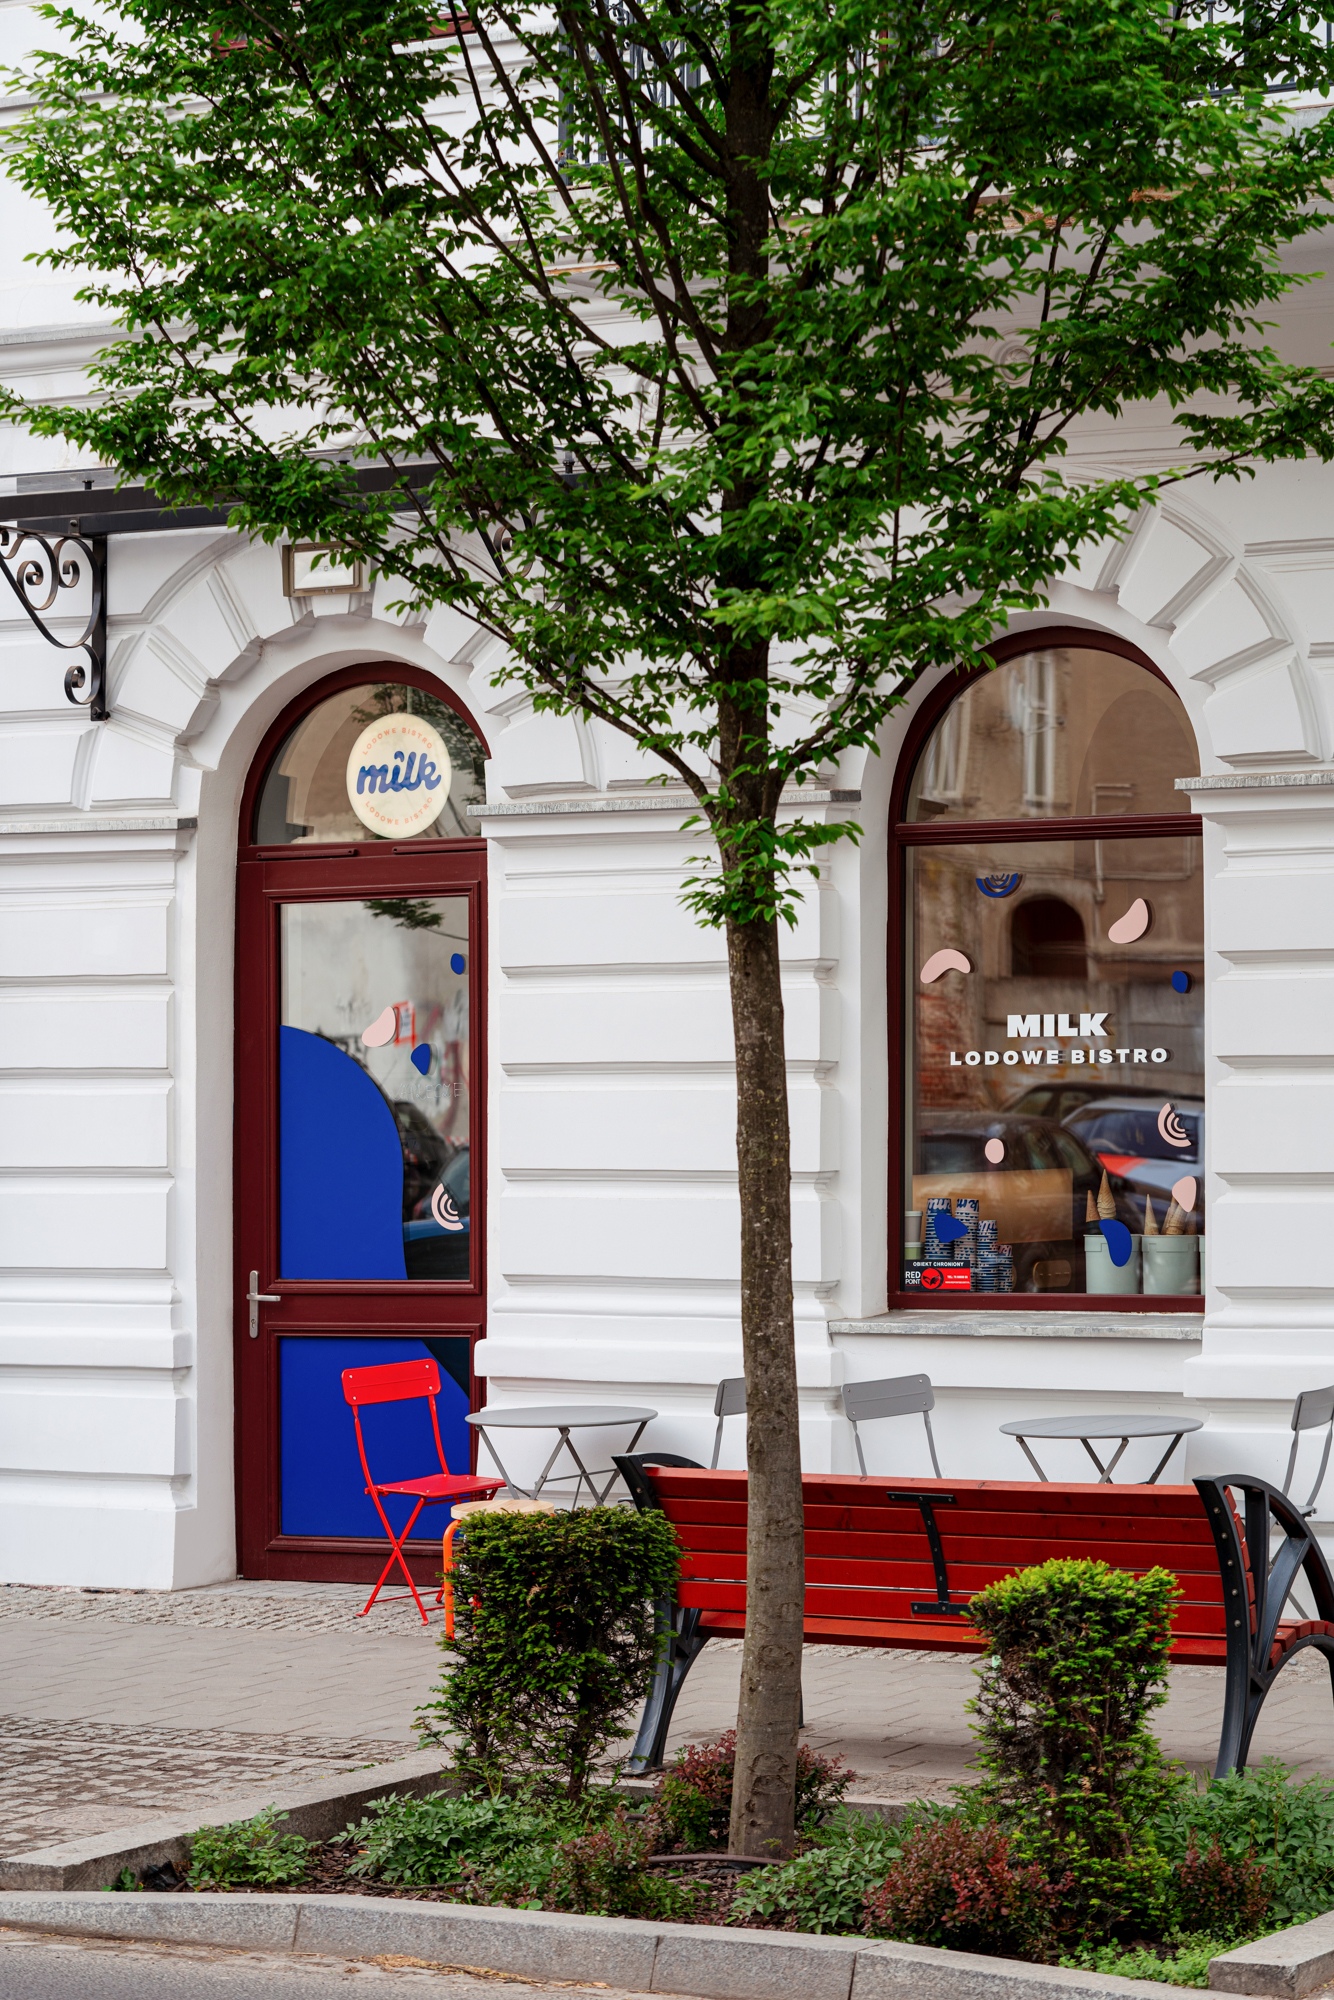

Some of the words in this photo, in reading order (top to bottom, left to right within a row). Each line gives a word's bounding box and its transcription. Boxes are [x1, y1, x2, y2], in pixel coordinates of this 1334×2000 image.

[362, 728, 397, 755] LODOWE
[402, 727, 432, 749] BISTRO
[365, 801, 399, 825] LODOWE
[404, 797, 432, 824] BISTRO
[1007, 1013, 1109, 1038] MILK
[950, 1050, 1059, 1066] LODOWE
[1071, 1048, 1167, 1064] BISTRO
[905, 1271, 921, 1279] RED
